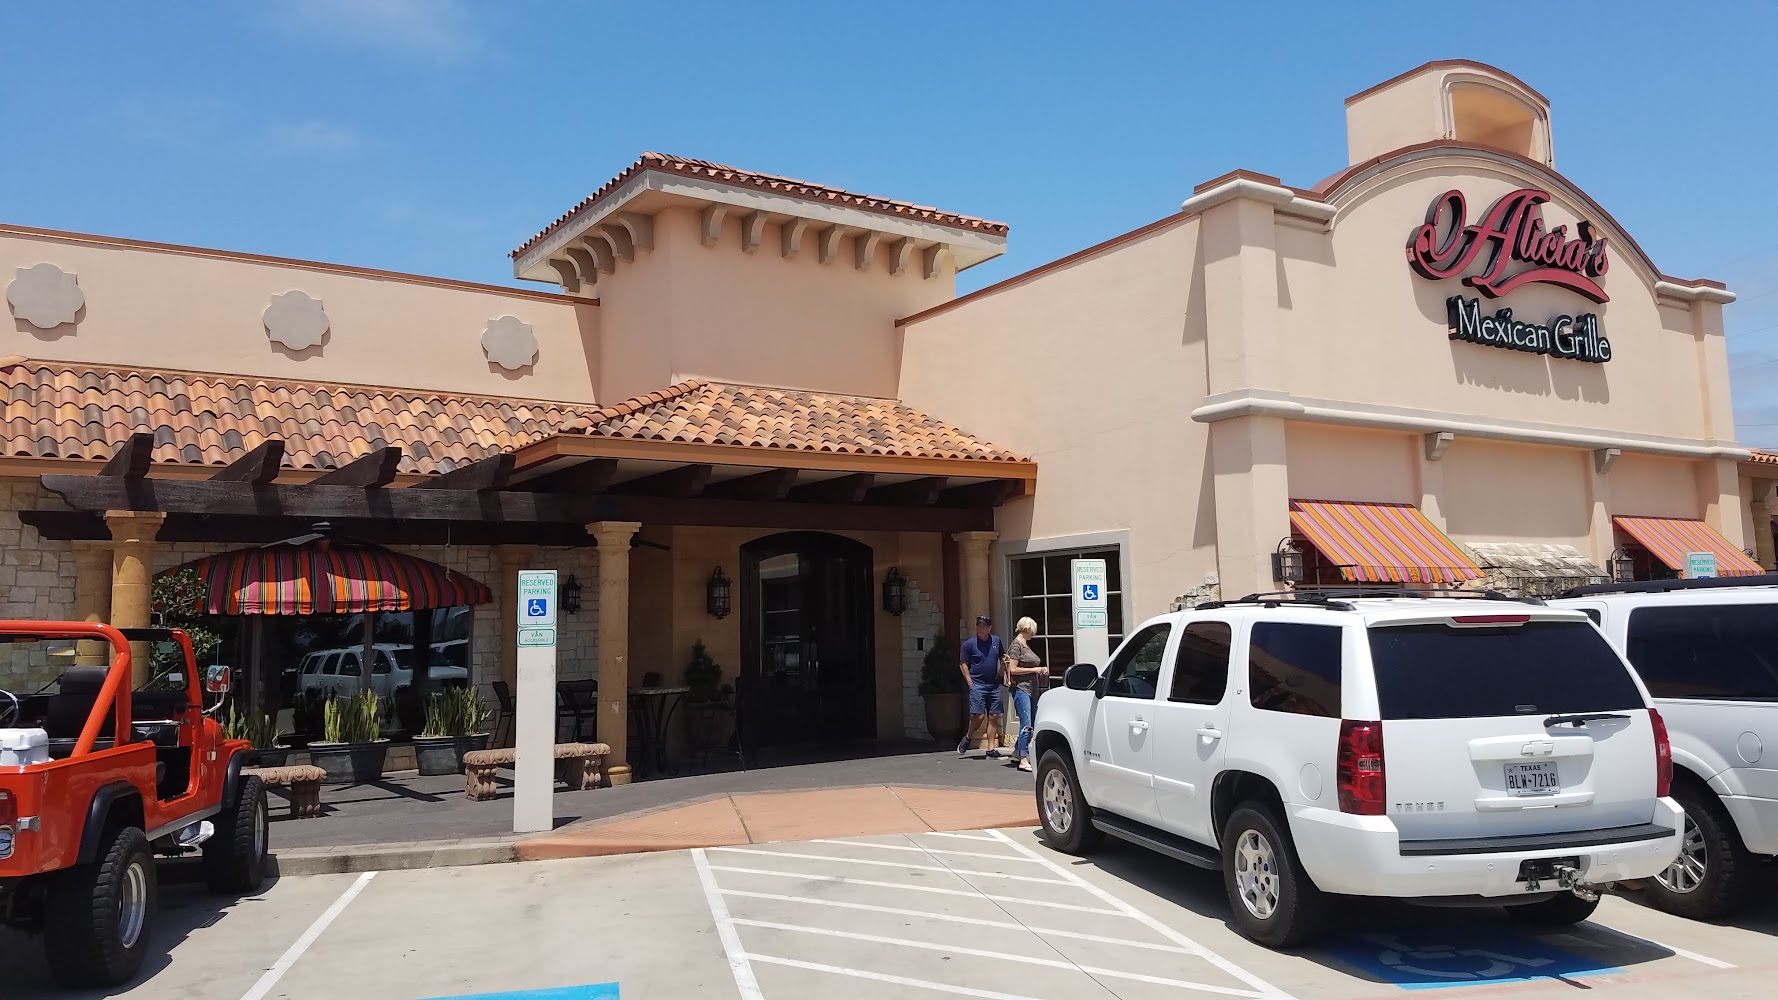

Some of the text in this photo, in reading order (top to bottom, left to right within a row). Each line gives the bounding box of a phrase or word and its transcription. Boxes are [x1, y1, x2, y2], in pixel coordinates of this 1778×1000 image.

[1412, 189, 1610, 303] Alicia's
[1457, 298, 1610, 360] Mexican Grille
[521, 579, 554, 587] RESERVED
